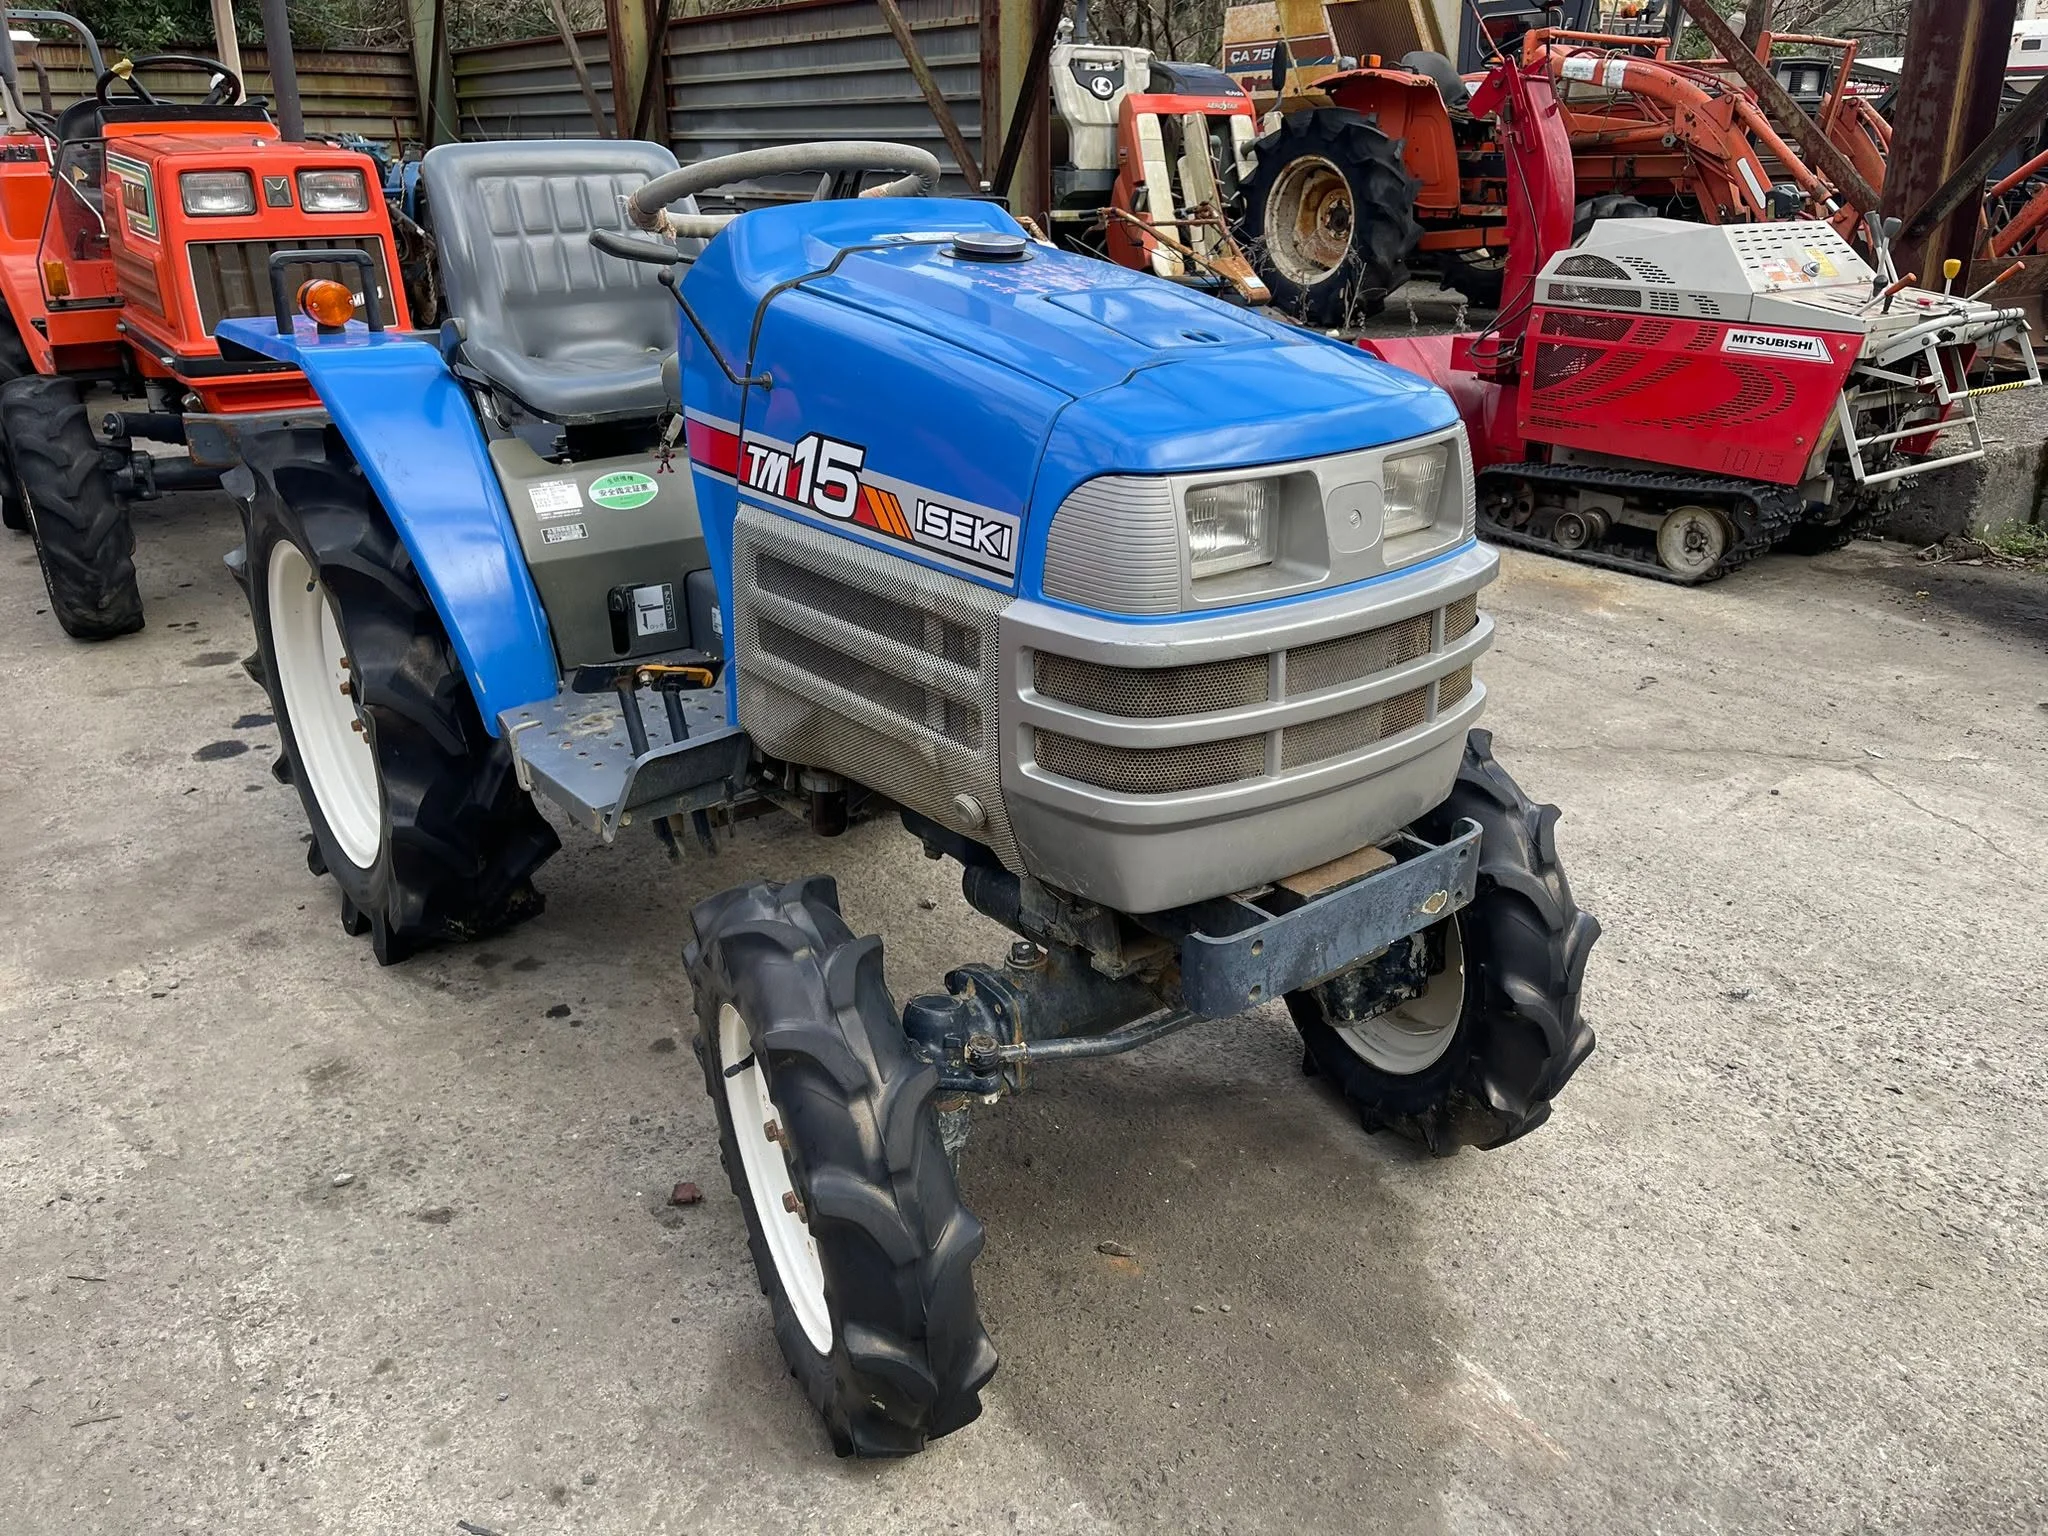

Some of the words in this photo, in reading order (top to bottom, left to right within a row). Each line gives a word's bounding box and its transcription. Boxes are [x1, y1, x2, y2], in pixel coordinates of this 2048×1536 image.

[1230, 50, 1249, 64] CA
[1732, 334, 1813, 350] MITSUBISHI
[915, 499, 1012, 561] ISEKI
